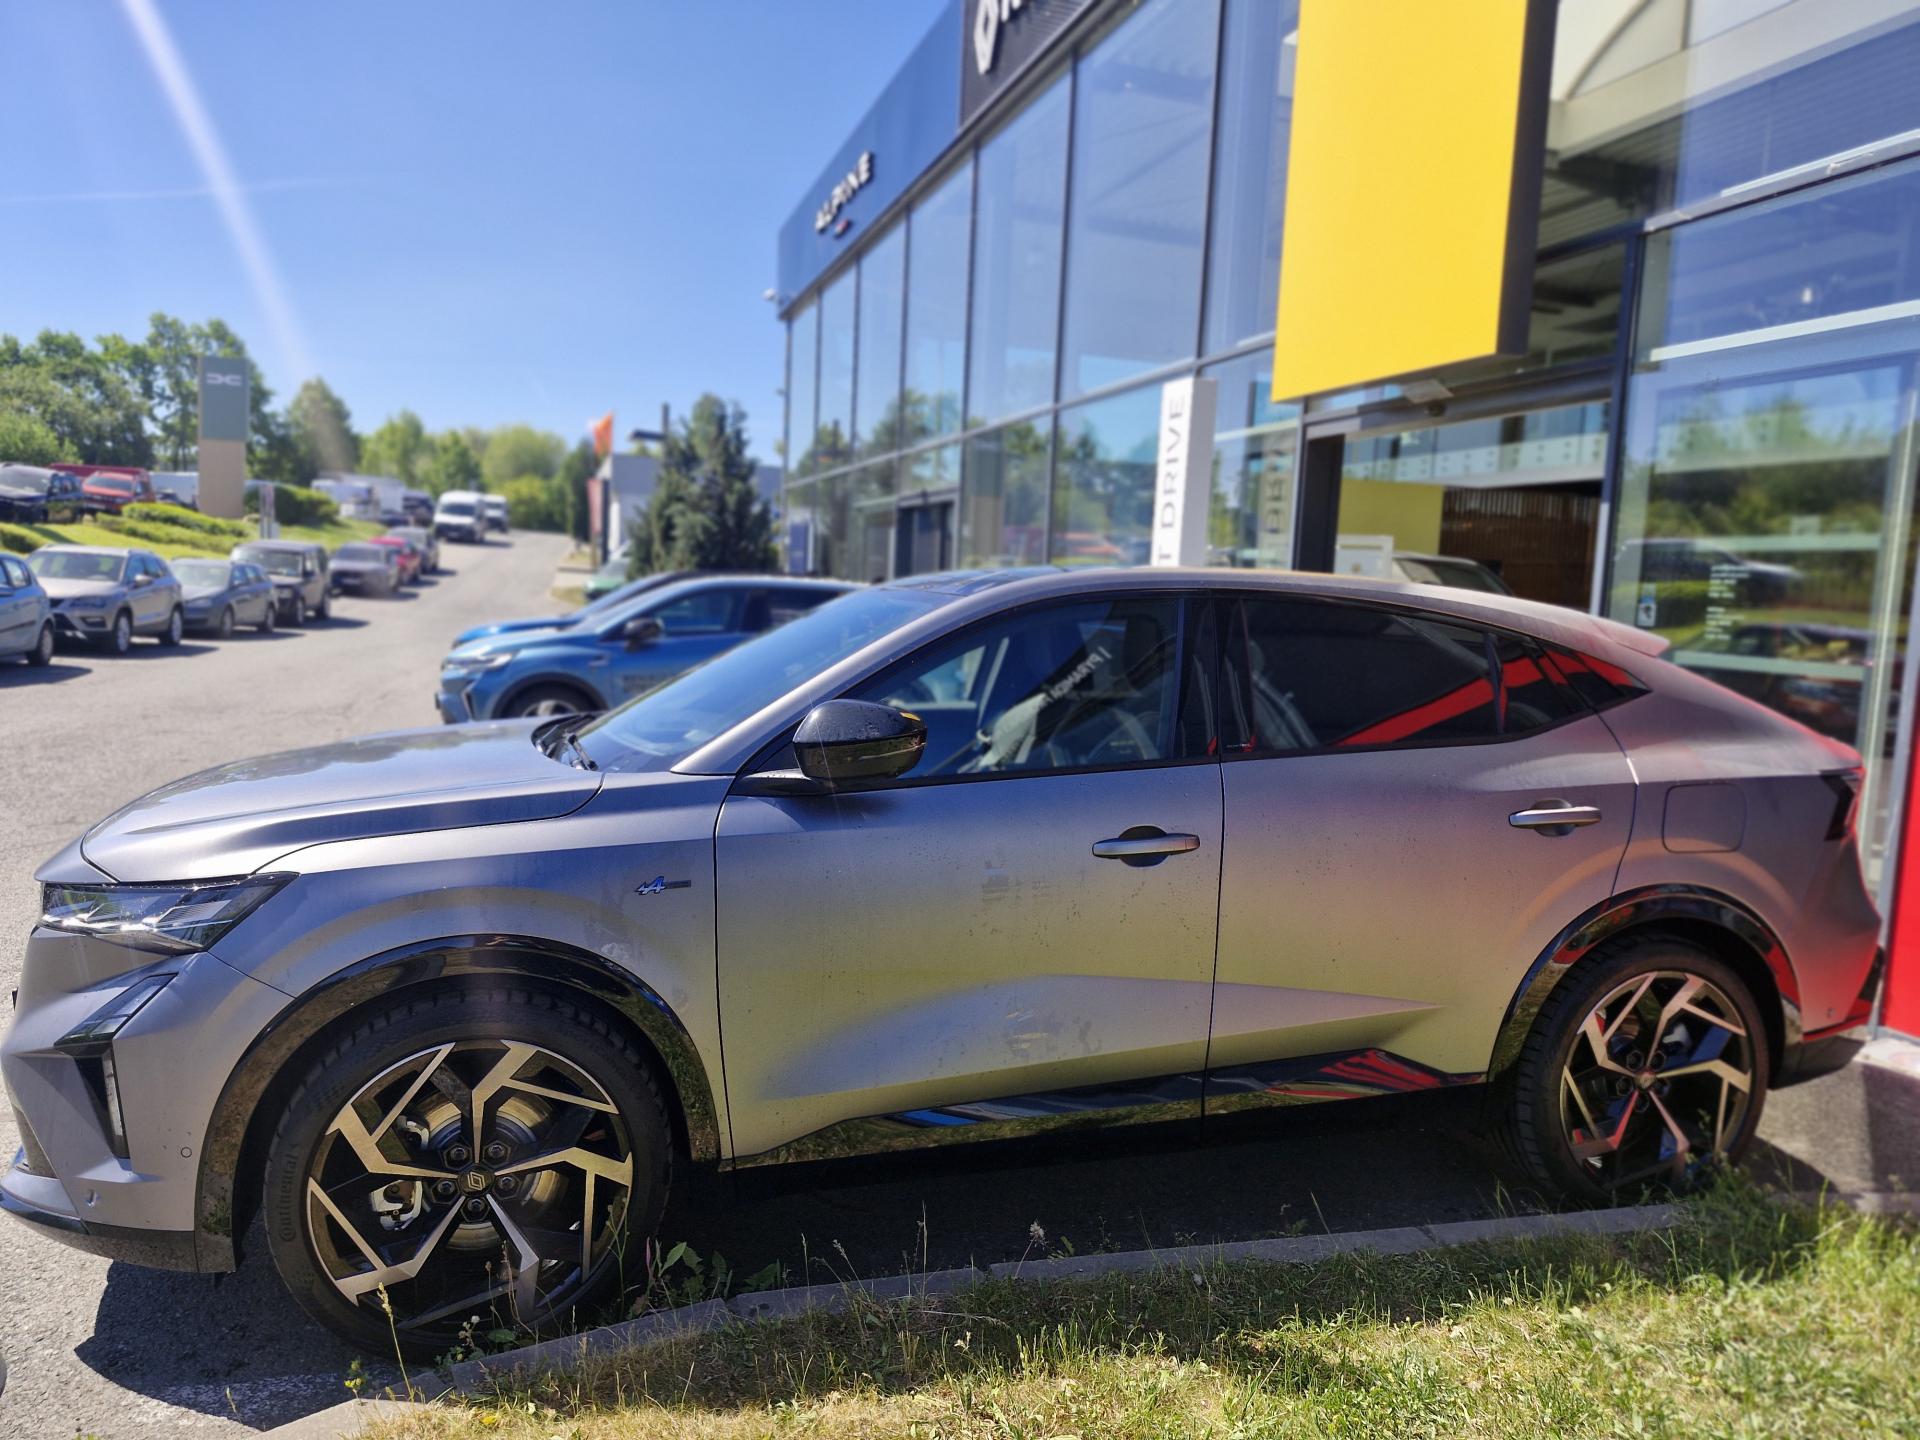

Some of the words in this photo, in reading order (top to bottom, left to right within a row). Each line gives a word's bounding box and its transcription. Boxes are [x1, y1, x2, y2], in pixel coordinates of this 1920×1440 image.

[815, 150, 870, 231] ALPINE
[1160, 395, 1185, 528] DRIVE
[278, 1152, 299, 1243] Continental
